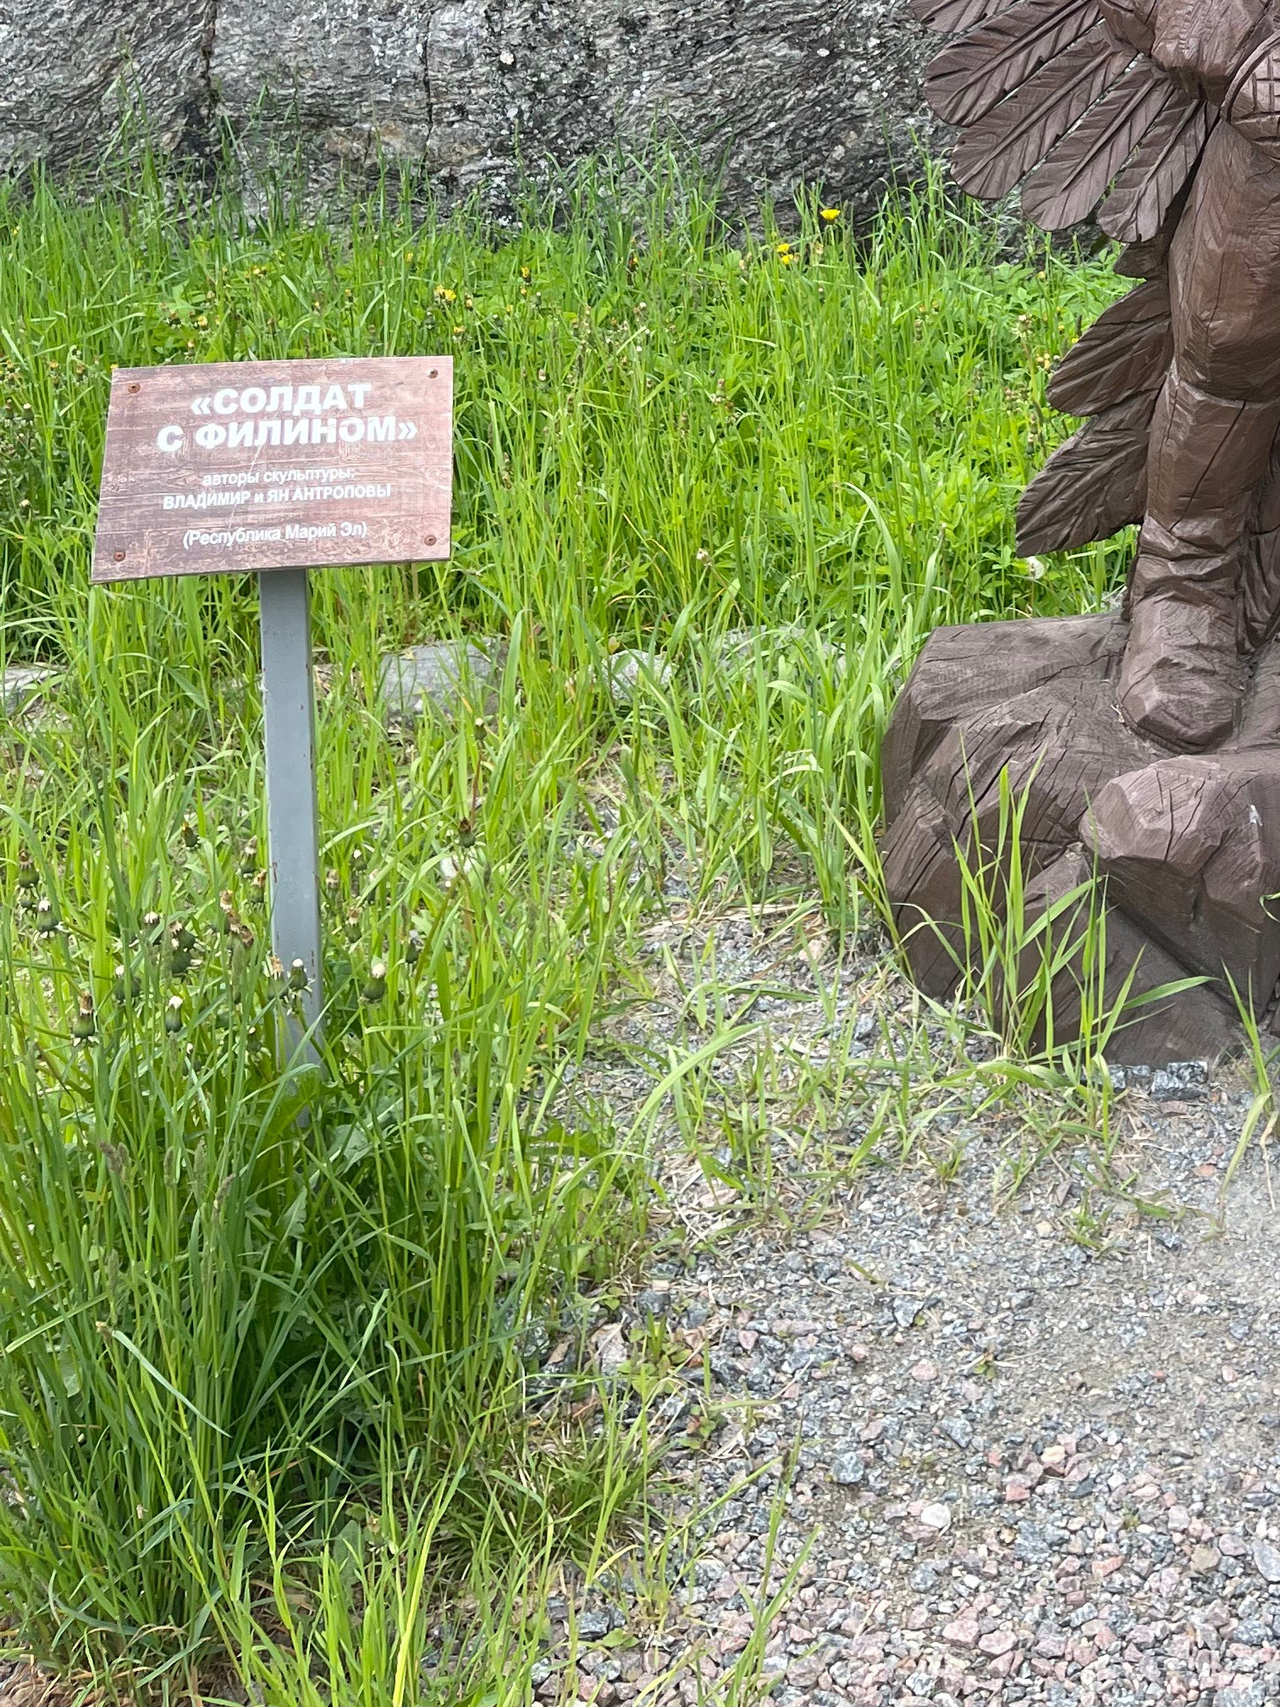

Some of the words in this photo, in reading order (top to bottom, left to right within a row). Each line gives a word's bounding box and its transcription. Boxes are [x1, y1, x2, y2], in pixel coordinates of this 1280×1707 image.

[191, 384, 372, 416] «СОЛДАТ
[195, 416, 418, 450] ФИЛИНОМ»
[202, 470, 260, 489] авторы
[263, 467, 355, 486] скульптуры:
[163, 490, 250, 510] ВЛАДИМИР
[254, 493, 264, 503] и
[267, 488, 290, 502] ЯН
[292, 484, 391, 501] АНТРОПОВЫ
[182, 527, 281, 550] (Республика
[285, 522, 337, 540] Марий
[340, 521, 368, 538] Эл)
